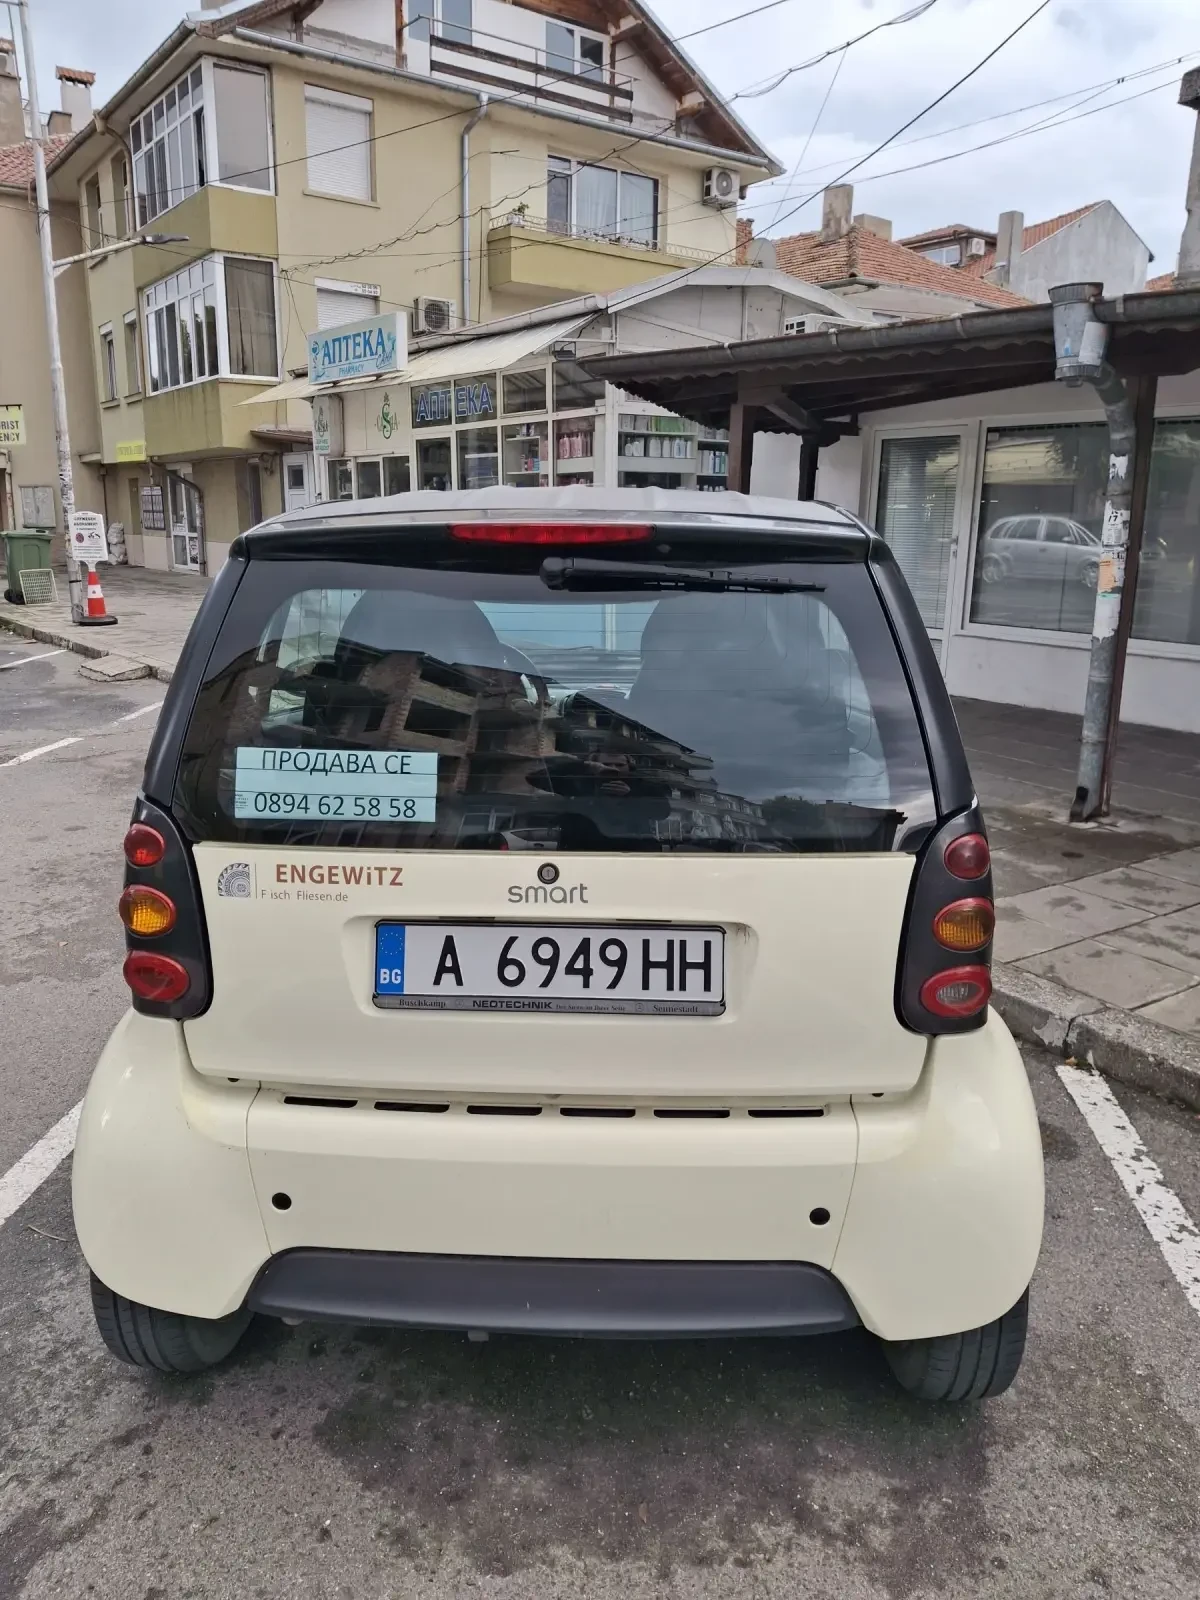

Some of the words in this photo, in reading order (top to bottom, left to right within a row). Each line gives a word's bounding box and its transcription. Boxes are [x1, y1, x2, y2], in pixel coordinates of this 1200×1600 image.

[322, 328, 387, 366] АПТЕКА
[339, 364, 364, 376] PHARMACY
[416, 382, 493, 422] АПТЕКА
[262, 750, 376, 775] ПРОДАВА
[384, 755, 412, 774] СЕ
[254, 793, 311, 814] 0894
[318, 796, 345, 816] 62
[353, 797, 381, 817] 58
[388, 798, 416, 818] 58
[296, 890, 348, 902] Fliesen.de
[507, 883, 589, 904] smart
[379, 968, 402, 985] BG
[432, 934, 464, 986] A
[496, 935, 629, 990] 6949
[642, 938, 712, 992] HH
[399, 999, 446, 1009] Buschkamp
[472, 999, 553, 1010] NEOTECHNIK
[652, 1004, 699, 1014] Sennestadt
